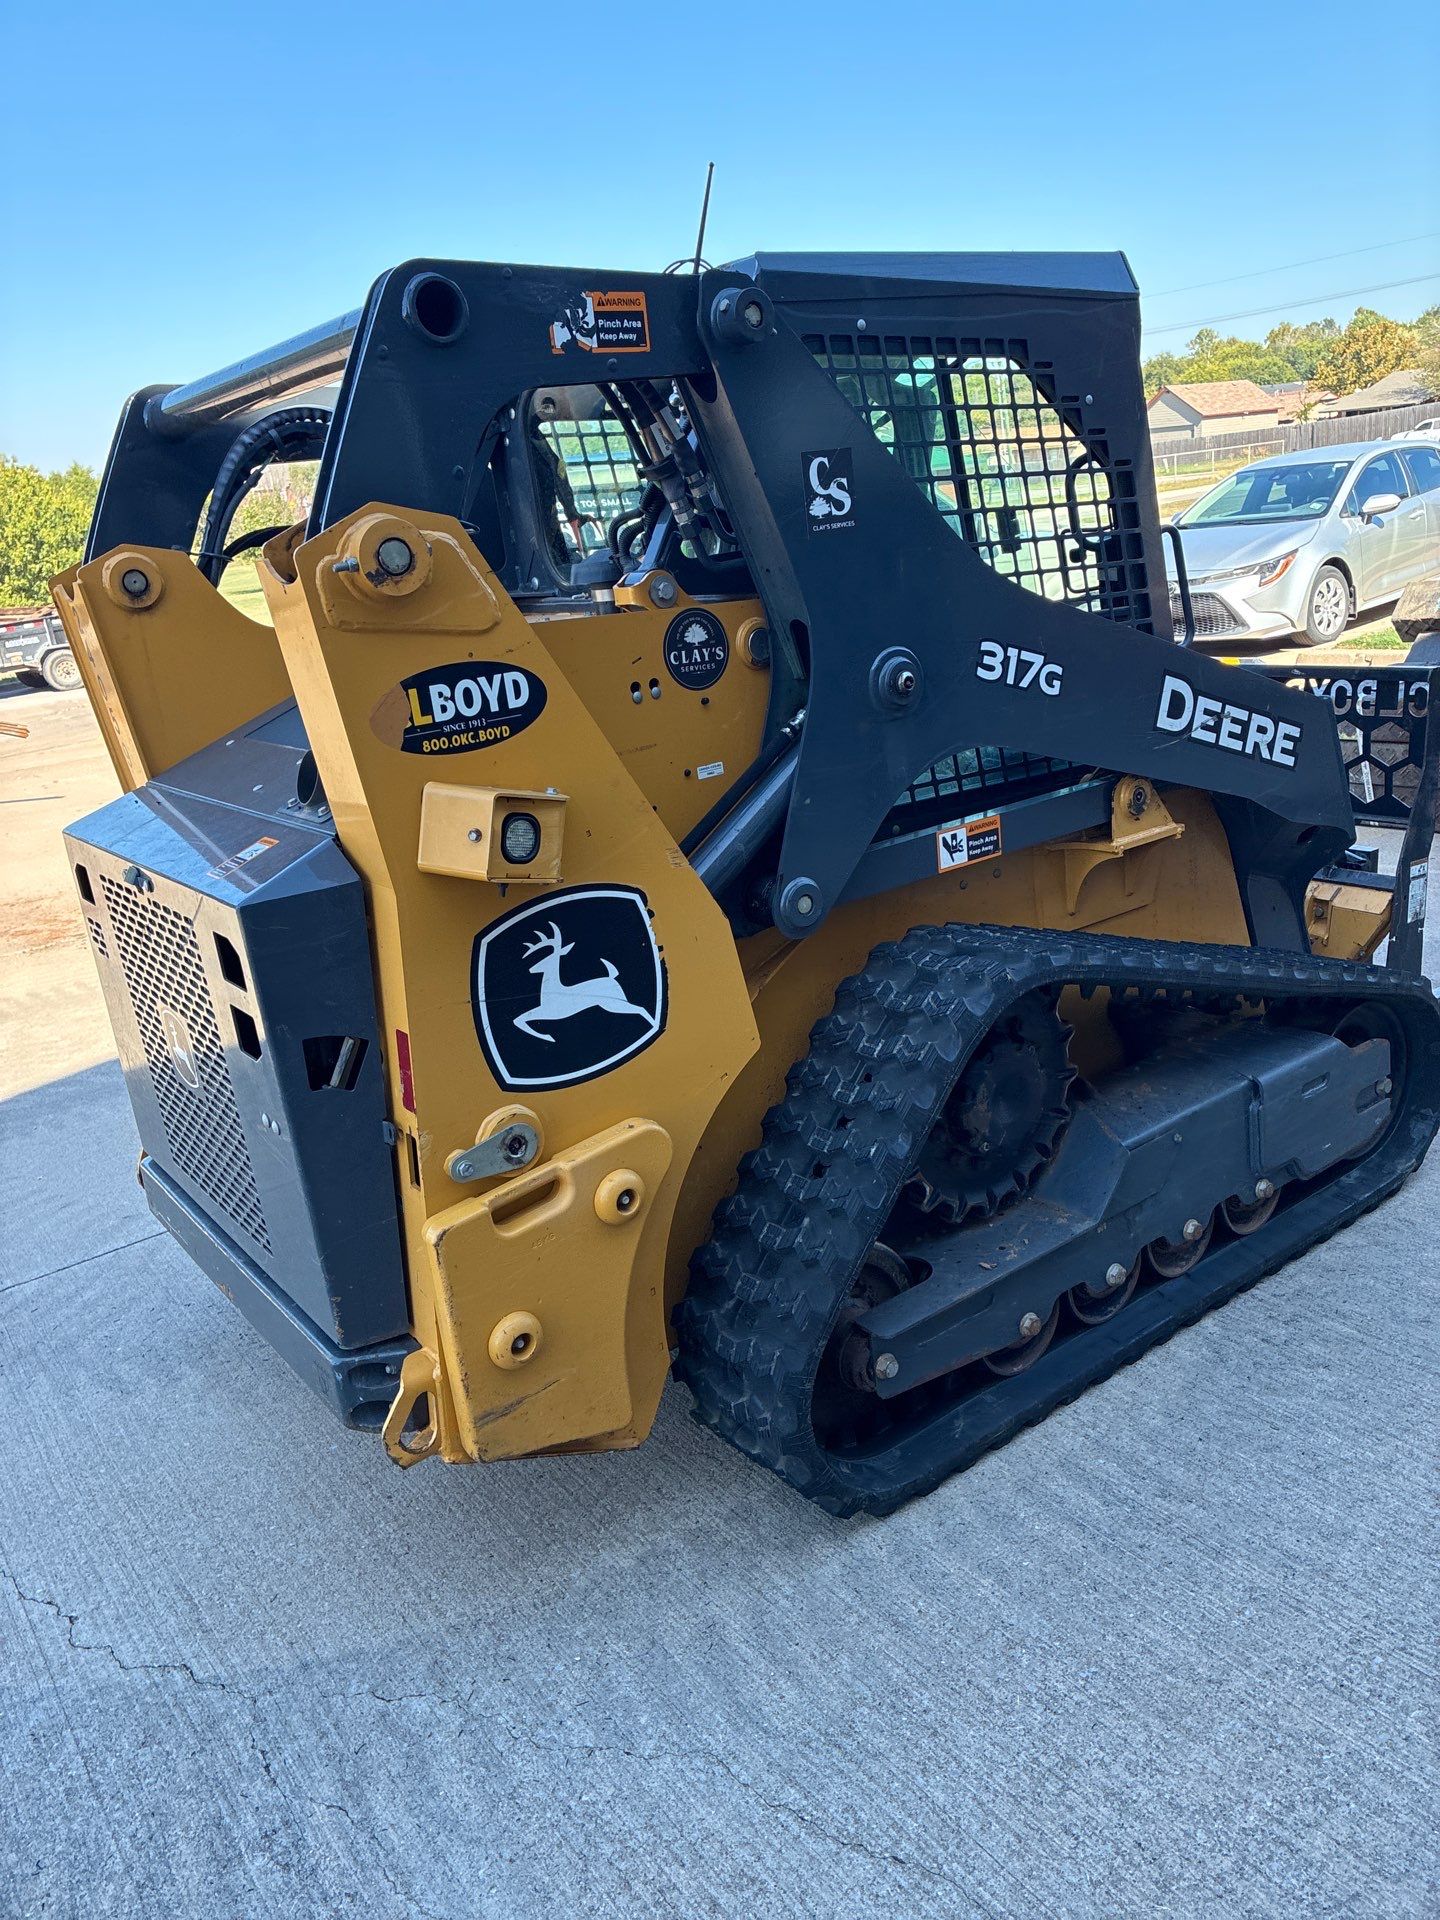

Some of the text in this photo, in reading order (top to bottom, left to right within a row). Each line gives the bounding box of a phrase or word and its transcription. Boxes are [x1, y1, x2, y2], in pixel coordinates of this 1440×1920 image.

[604, 297, 642, 307] WARNING
[598, 319, 642, 328] Pinch Area
[599, 332, 637, 341] Keep Away
[812, 520, 856, 532] CLAY'S SERVICES
[669, 646, 725, 665] CLAY'S
[680, 662, 716, 673] SERVICES
[976, 641, 1063, 696] 317G
[408, 671, 530, 727] LBOYD
[442, 718, 487, 733] SINCE 1913
[1156, 674, 1301, 767] DEERE
[973, 819, 998, 831] WARNING
[968, 835, 997, 847] Pinch Area
[969, 848, 981, 856] Keep
